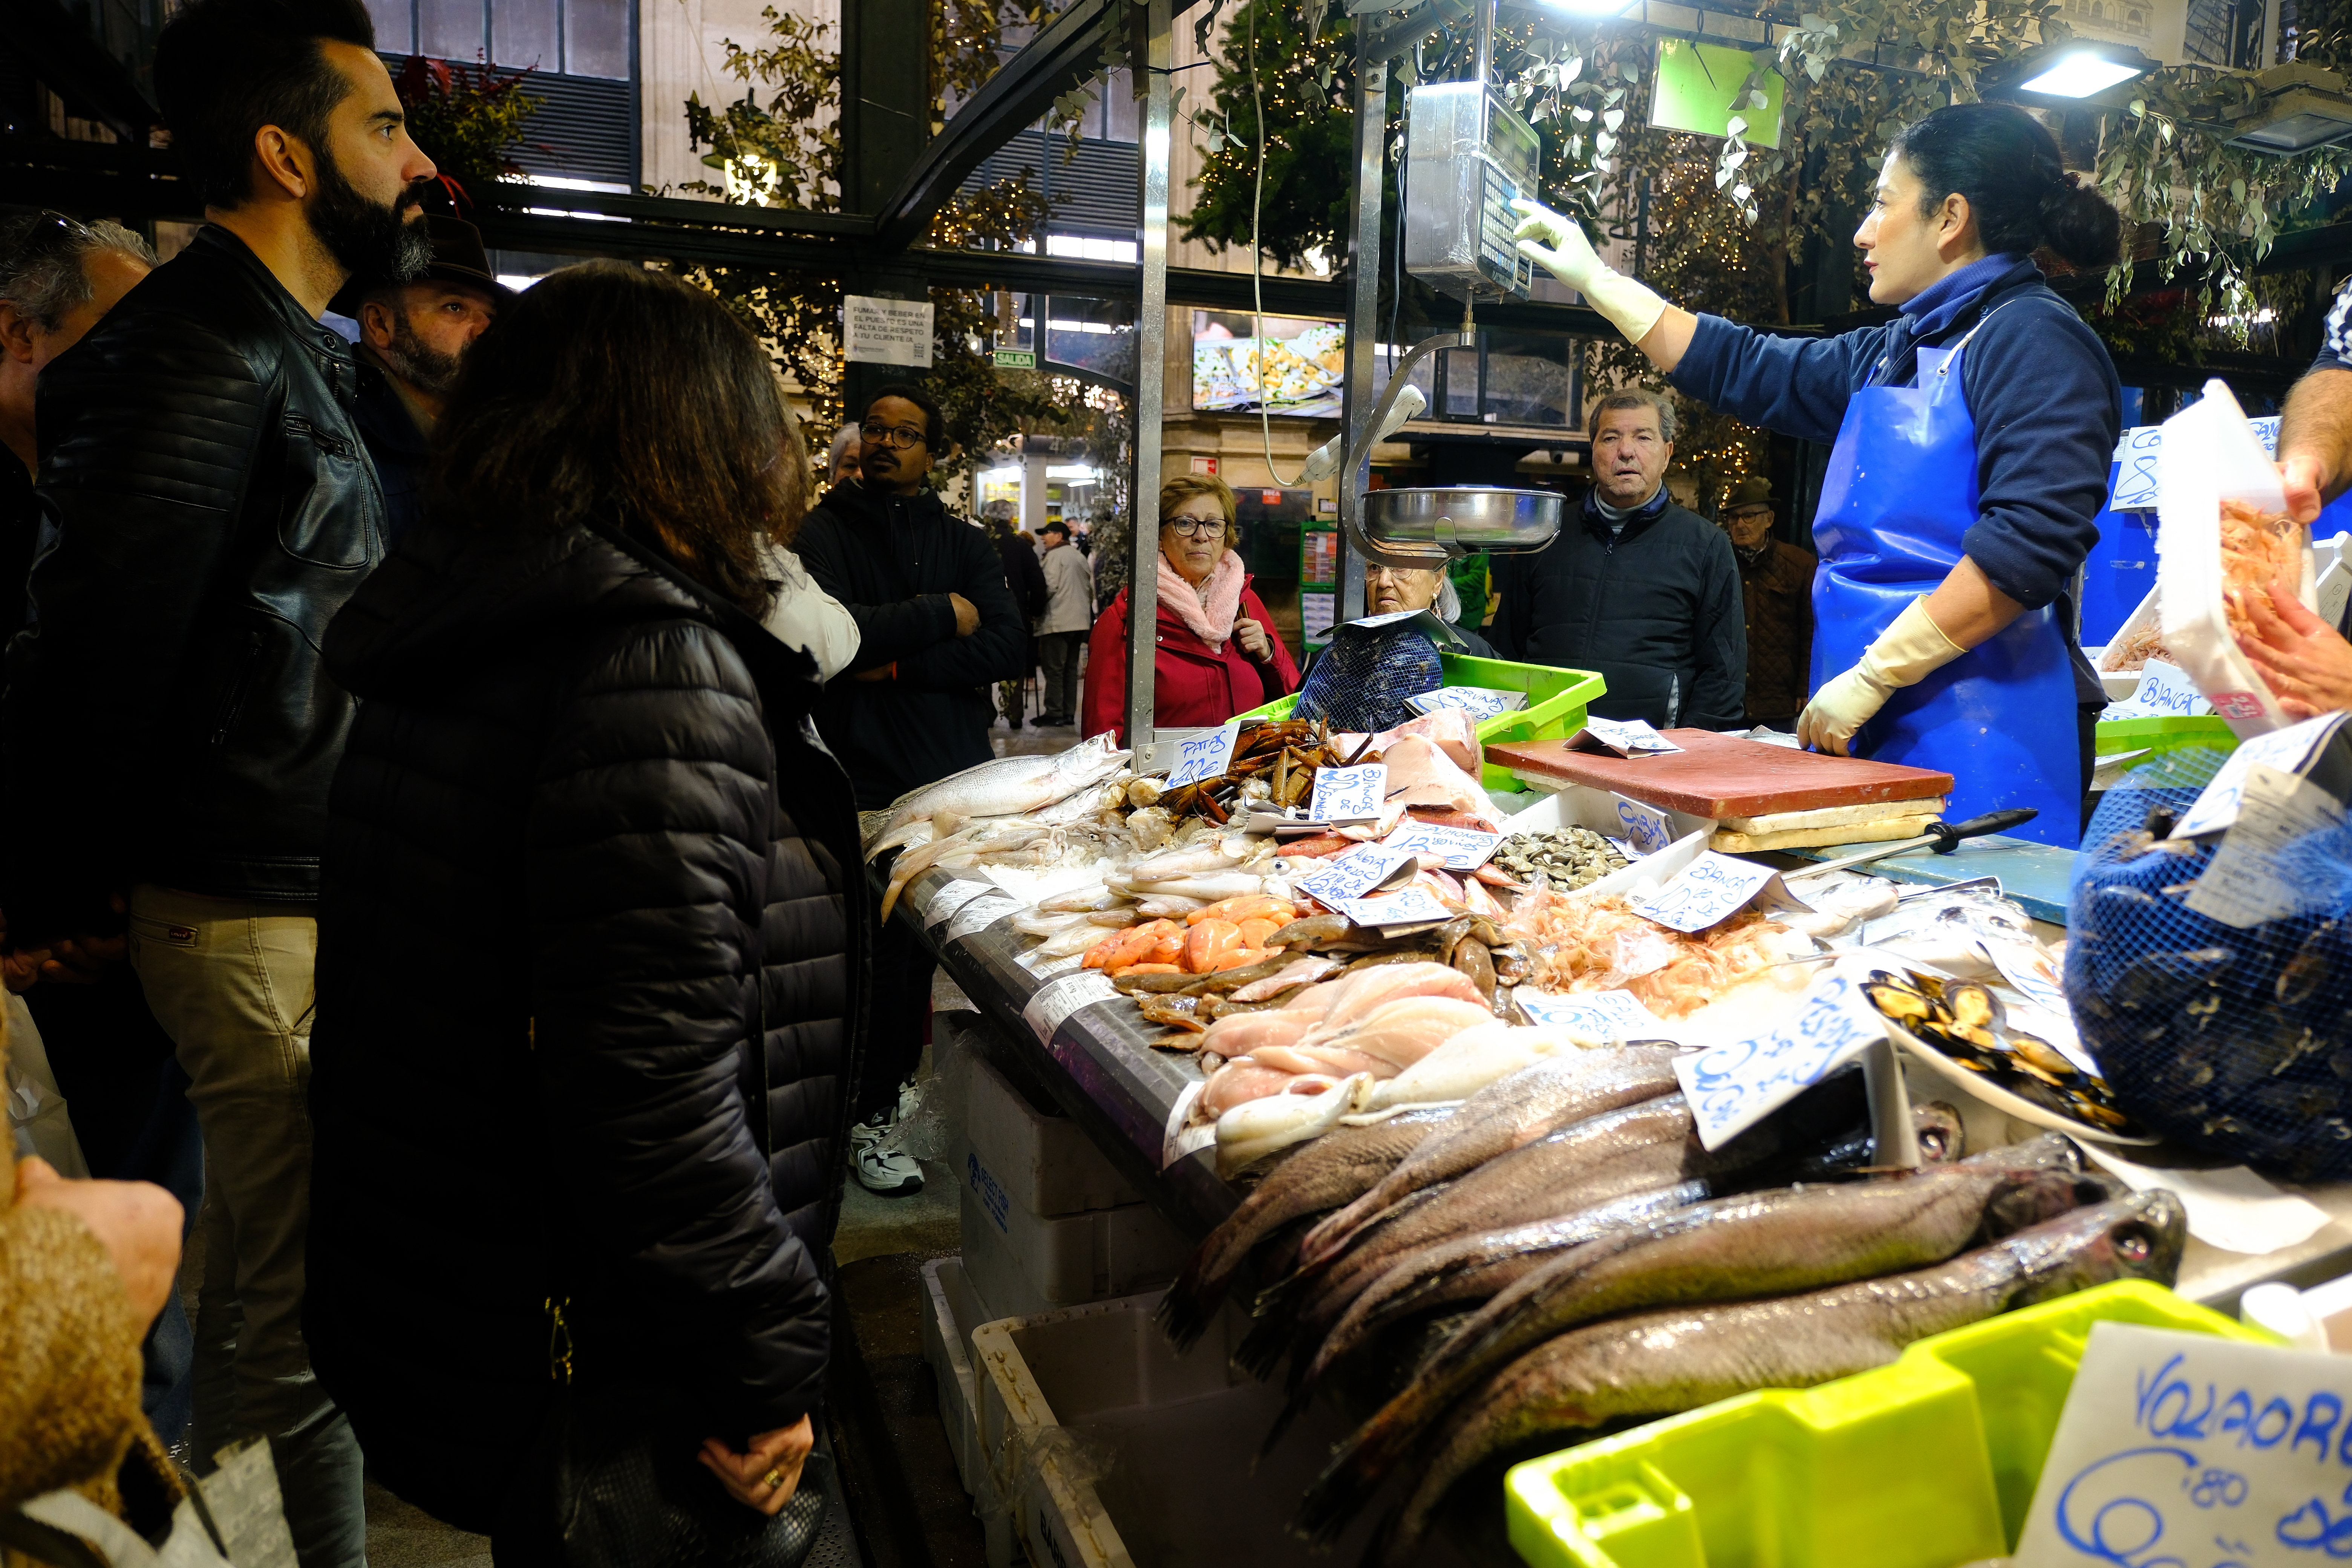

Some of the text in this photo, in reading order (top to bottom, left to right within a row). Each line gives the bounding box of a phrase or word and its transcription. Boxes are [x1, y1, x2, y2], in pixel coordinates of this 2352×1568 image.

[888, 310, 913, 318] BEBER
[873, 334, 904, 342] CLIENTE
[890, 327, 924, 336] RESPETO
[997, 353, 1032, 366] SALIDA
[1181, 730, 1227, 759] PATAS
[1352, 768, 1382, 815] BLANCAS
[1340, 799, 1351, 810] DE
[1354, 847, 1394, 880] HUEVAS
[1690, 860, 1757, 904] BLANCAS
[1697, 901, 1720, 917] DE
[1595, 994, 1644, 1028] GALLO
[981, 1167, 997, 1200] SELECT
[998, 1188, 1008, 1215] FISH
